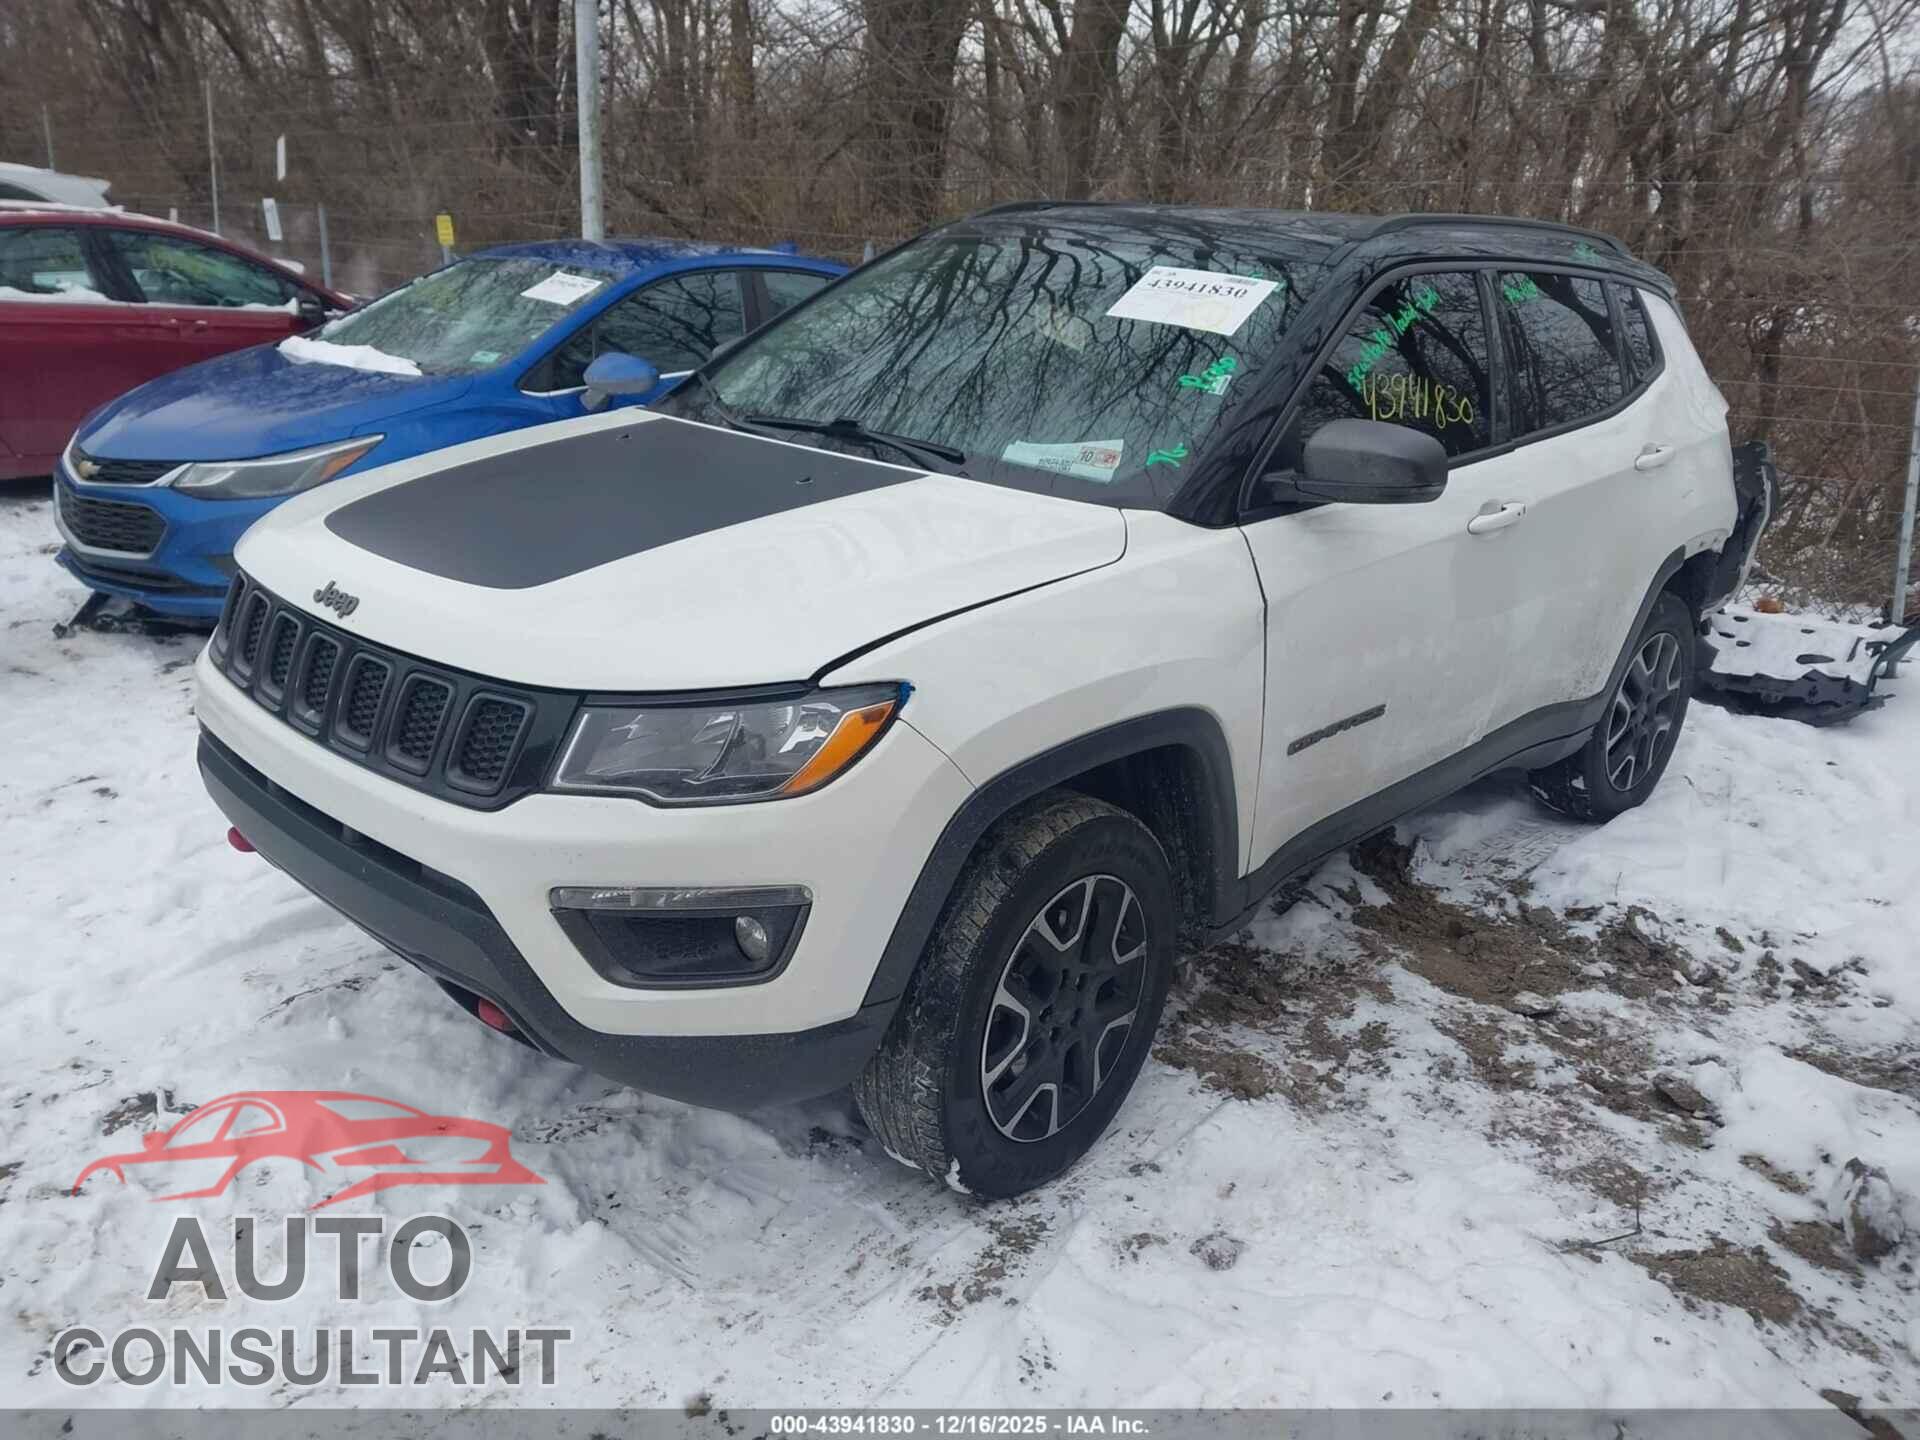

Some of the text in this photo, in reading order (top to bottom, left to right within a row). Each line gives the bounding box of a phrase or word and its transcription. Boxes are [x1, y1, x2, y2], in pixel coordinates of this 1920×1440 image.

[1147, 279, 1248, 299] 43941830
[1362, 372, 1474, 429] 43941830
[313, 579, 360, 619] Jeep
